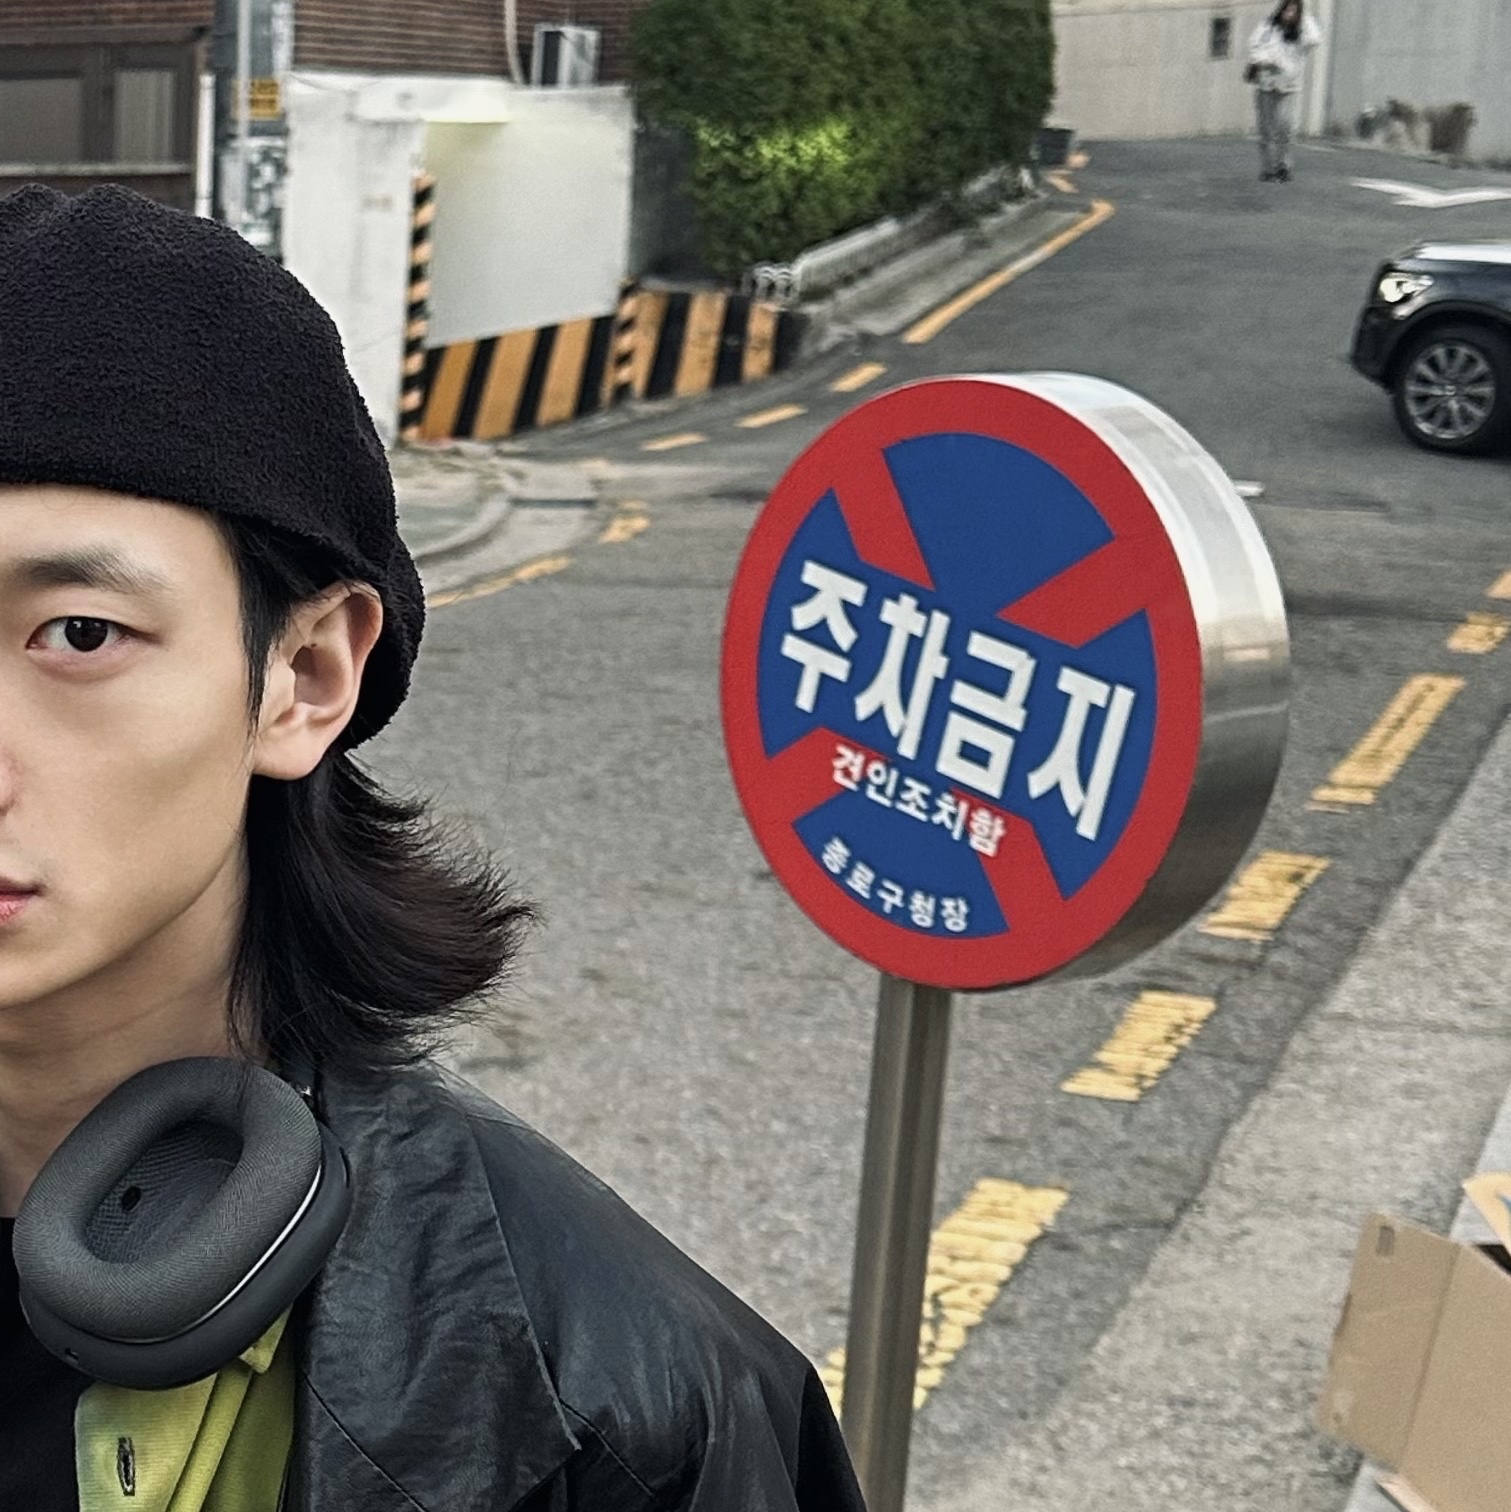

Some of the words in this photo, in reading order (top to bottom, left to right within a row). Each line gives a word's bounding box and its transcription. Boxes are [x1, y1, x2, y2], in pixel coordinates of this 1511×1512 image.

[781, 560, 1136, 841] 주차금지
[831, 743, 1007, 858] 견인조치함
[821, 836, 970, 932] 종로구청장
